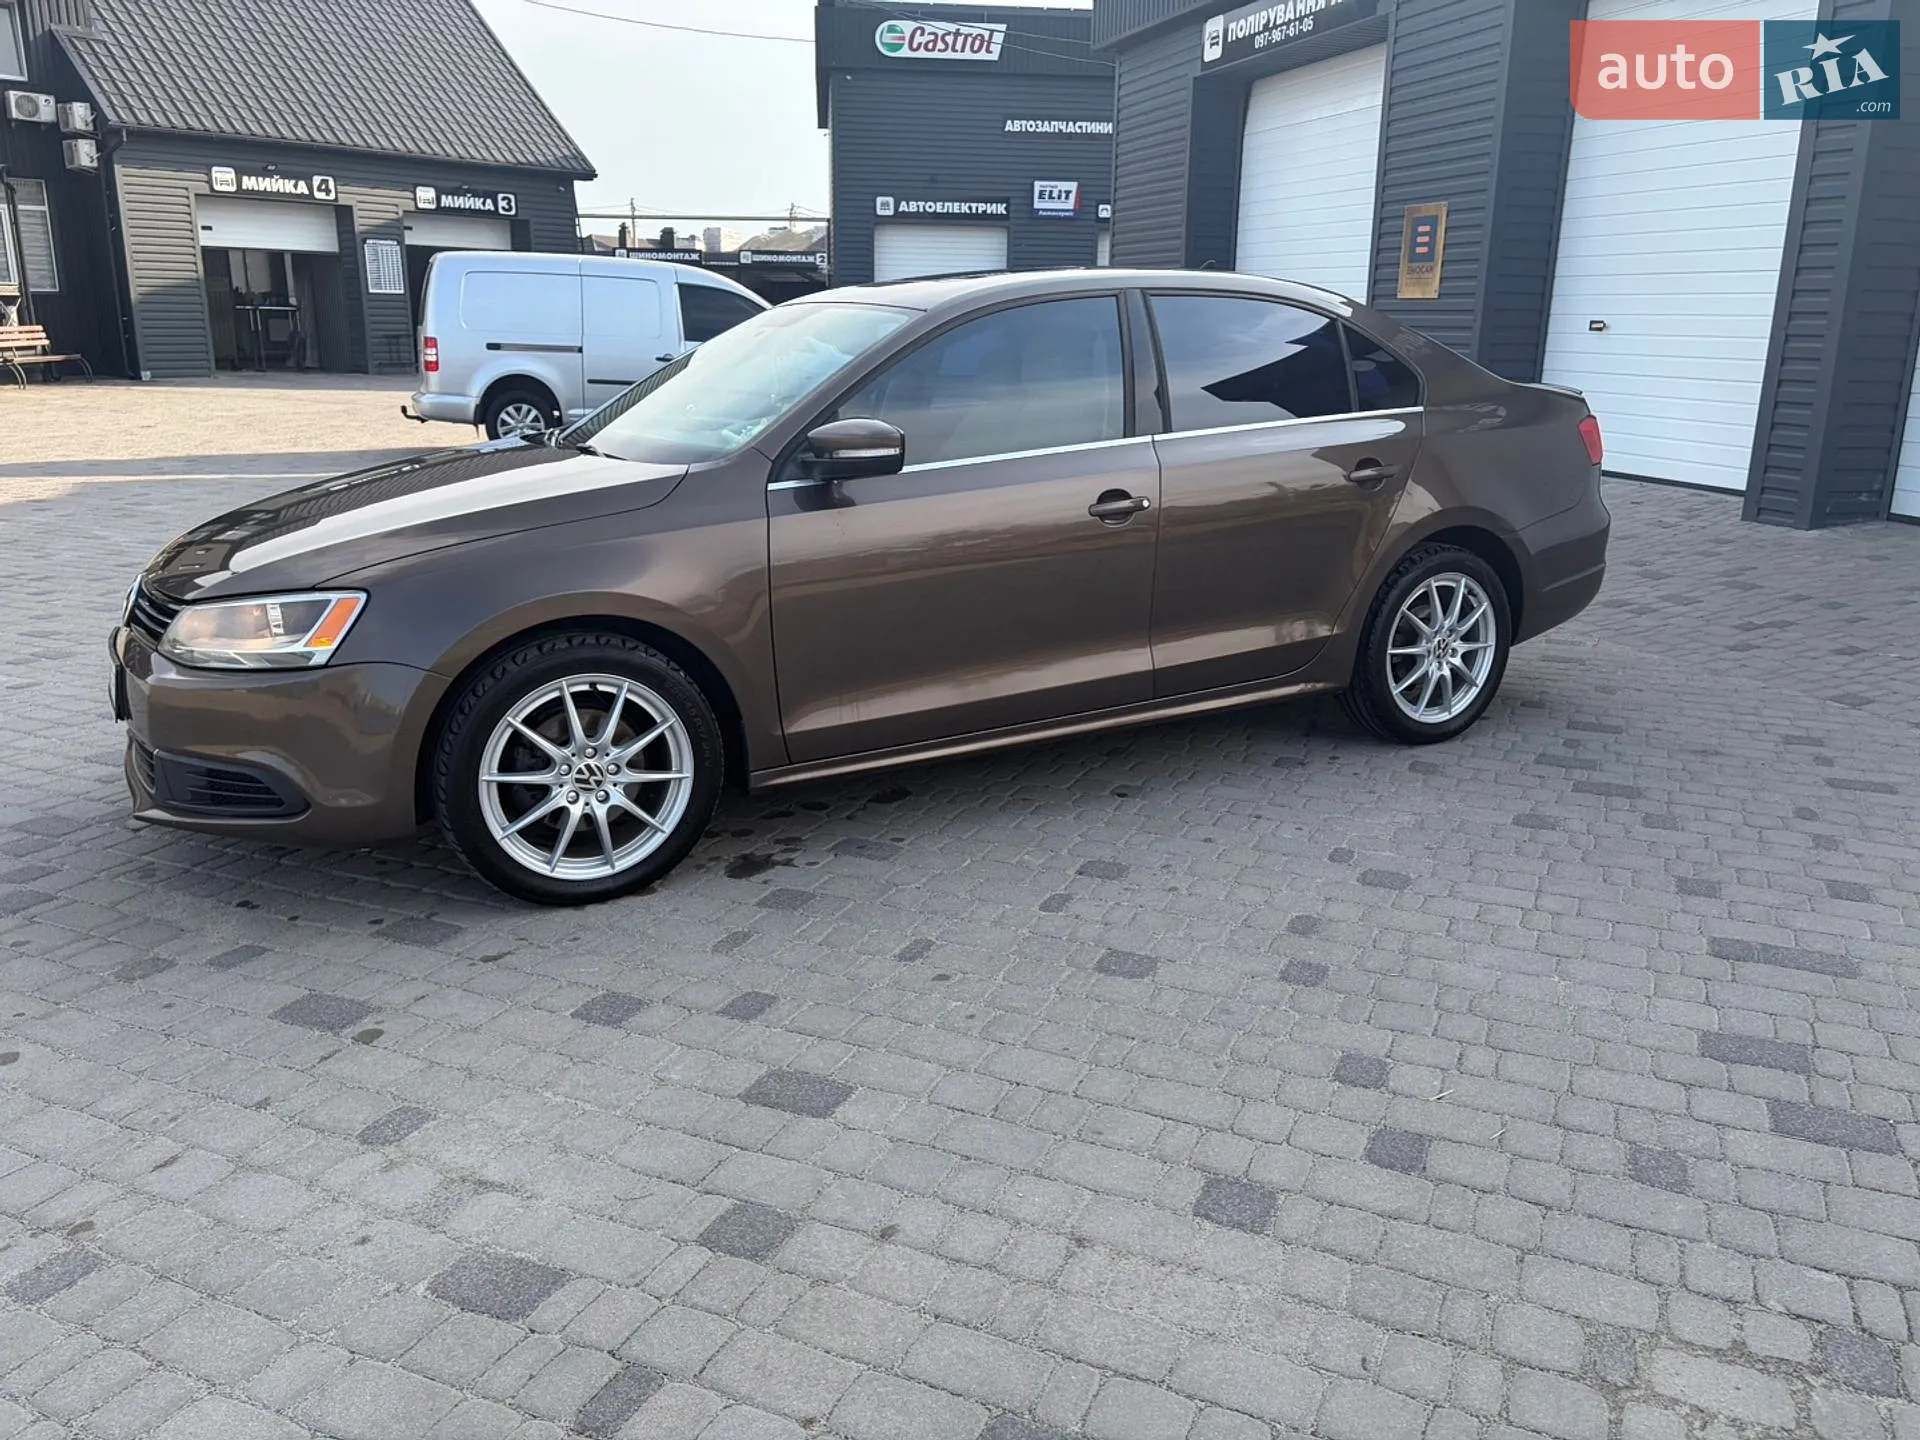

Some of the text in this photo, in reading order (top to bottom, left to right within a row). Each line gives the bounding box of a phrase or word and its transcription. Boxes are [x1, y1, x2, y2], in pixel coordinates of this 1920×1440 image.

[907, 25, 995, 54] Castrol
[1254, 16, 1314, 49] 097-967-61-05
[1004, 119, 1113, 134] АВТОЗАПЧАСТИНИ
[242, 175, 309, 195] МИЙКА
[440, 193, 495, 211] МИЙКА
[898, 200, 1007, 215] АВТОЕЛЕКТРИК
